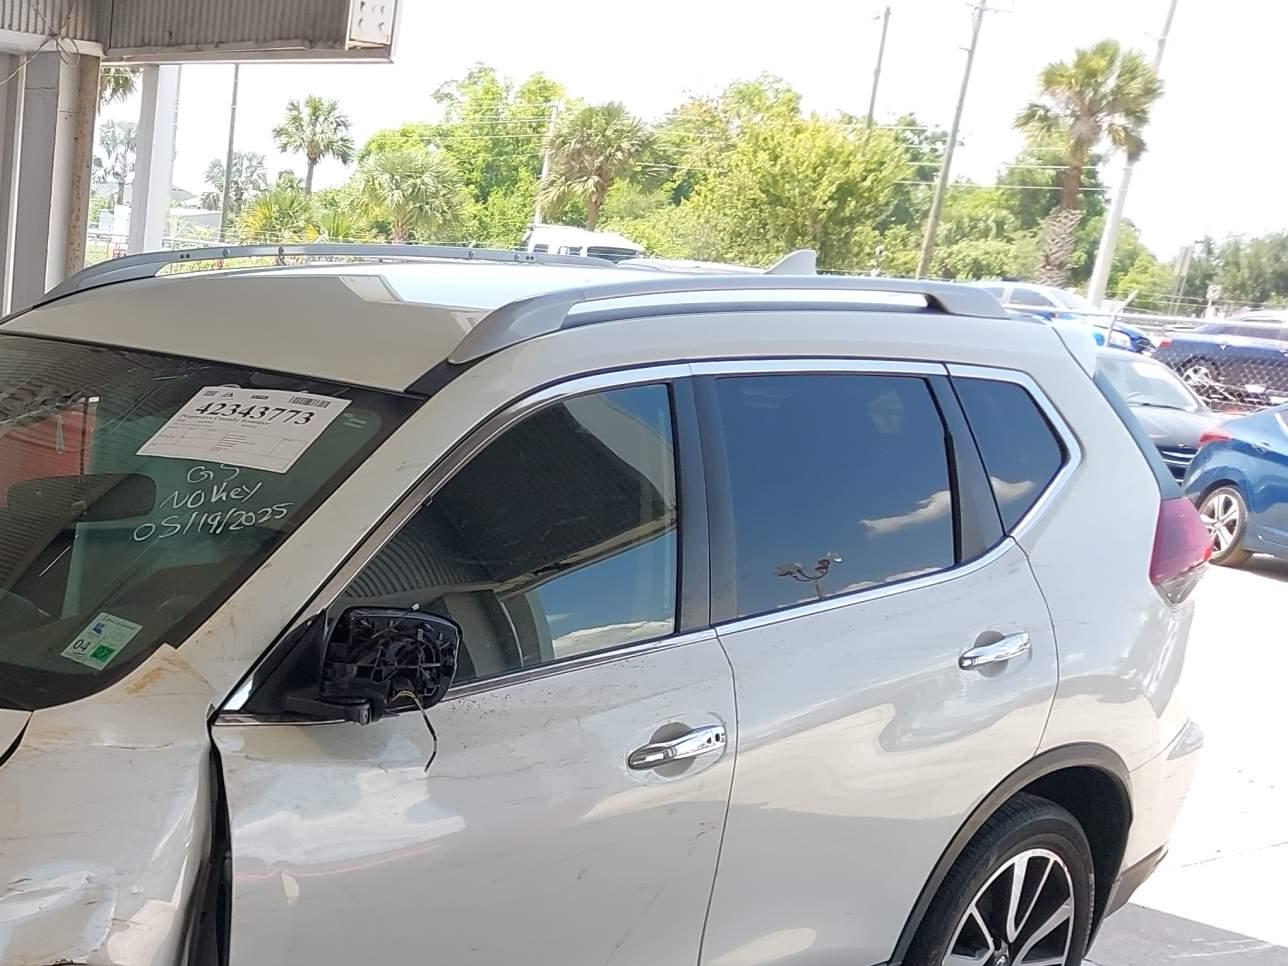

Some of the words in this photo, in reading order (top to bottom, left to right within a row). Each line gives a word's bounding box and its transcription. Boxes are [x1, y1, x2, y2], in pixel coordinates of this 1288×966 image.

[195, 402, 315, 425] 42343773
[133, 503, 296, 541] 05/19/2025
[73, 639, 91, 652] 04
